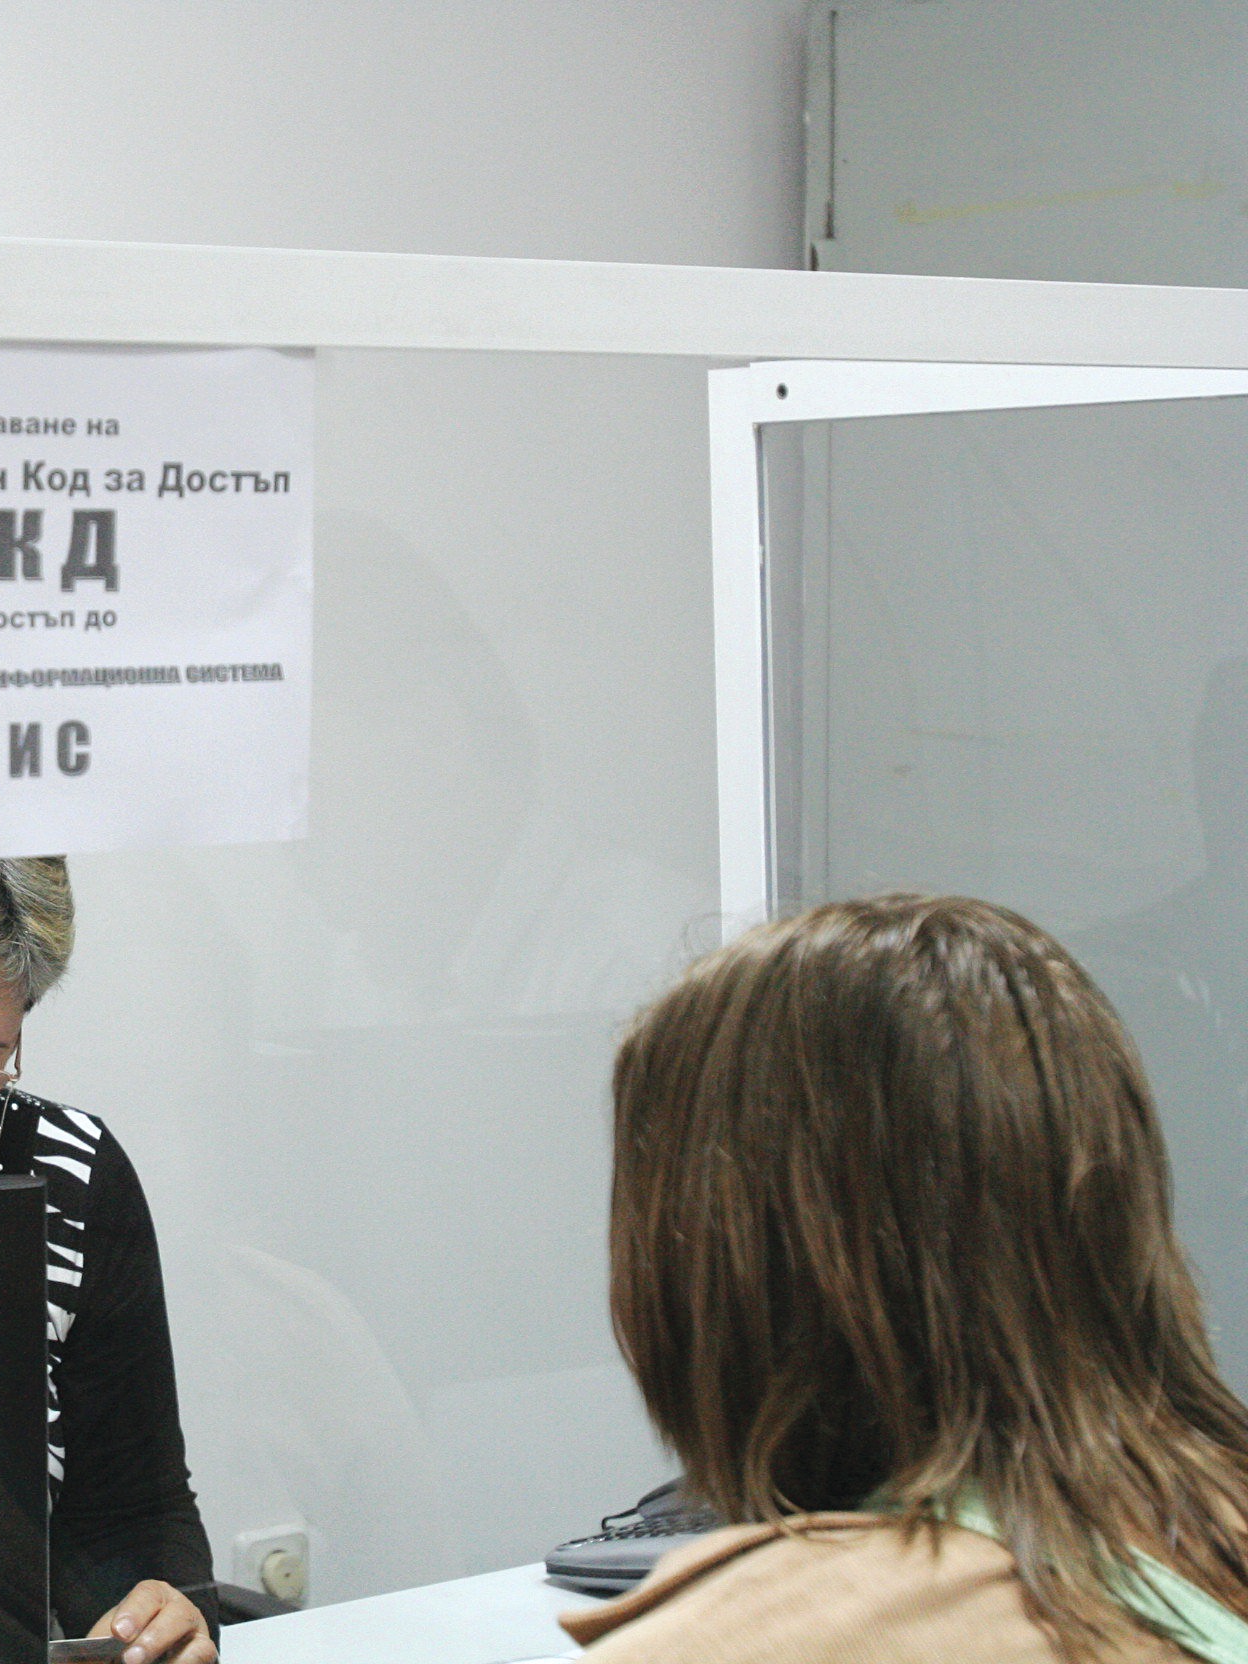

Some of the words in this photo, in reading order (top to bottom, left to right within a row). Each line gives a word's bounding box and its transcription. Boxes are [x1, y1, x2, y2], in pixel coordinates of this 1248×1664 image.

[87, 416, 120, 437] на
[22, 461, 91, 497] Код
[104, 468, 145, 493] за
[158, 462, 291, 498] Достъп
[84, 608, 118, 632] до
[185, 662, 284, 684] СИСТЕМА
